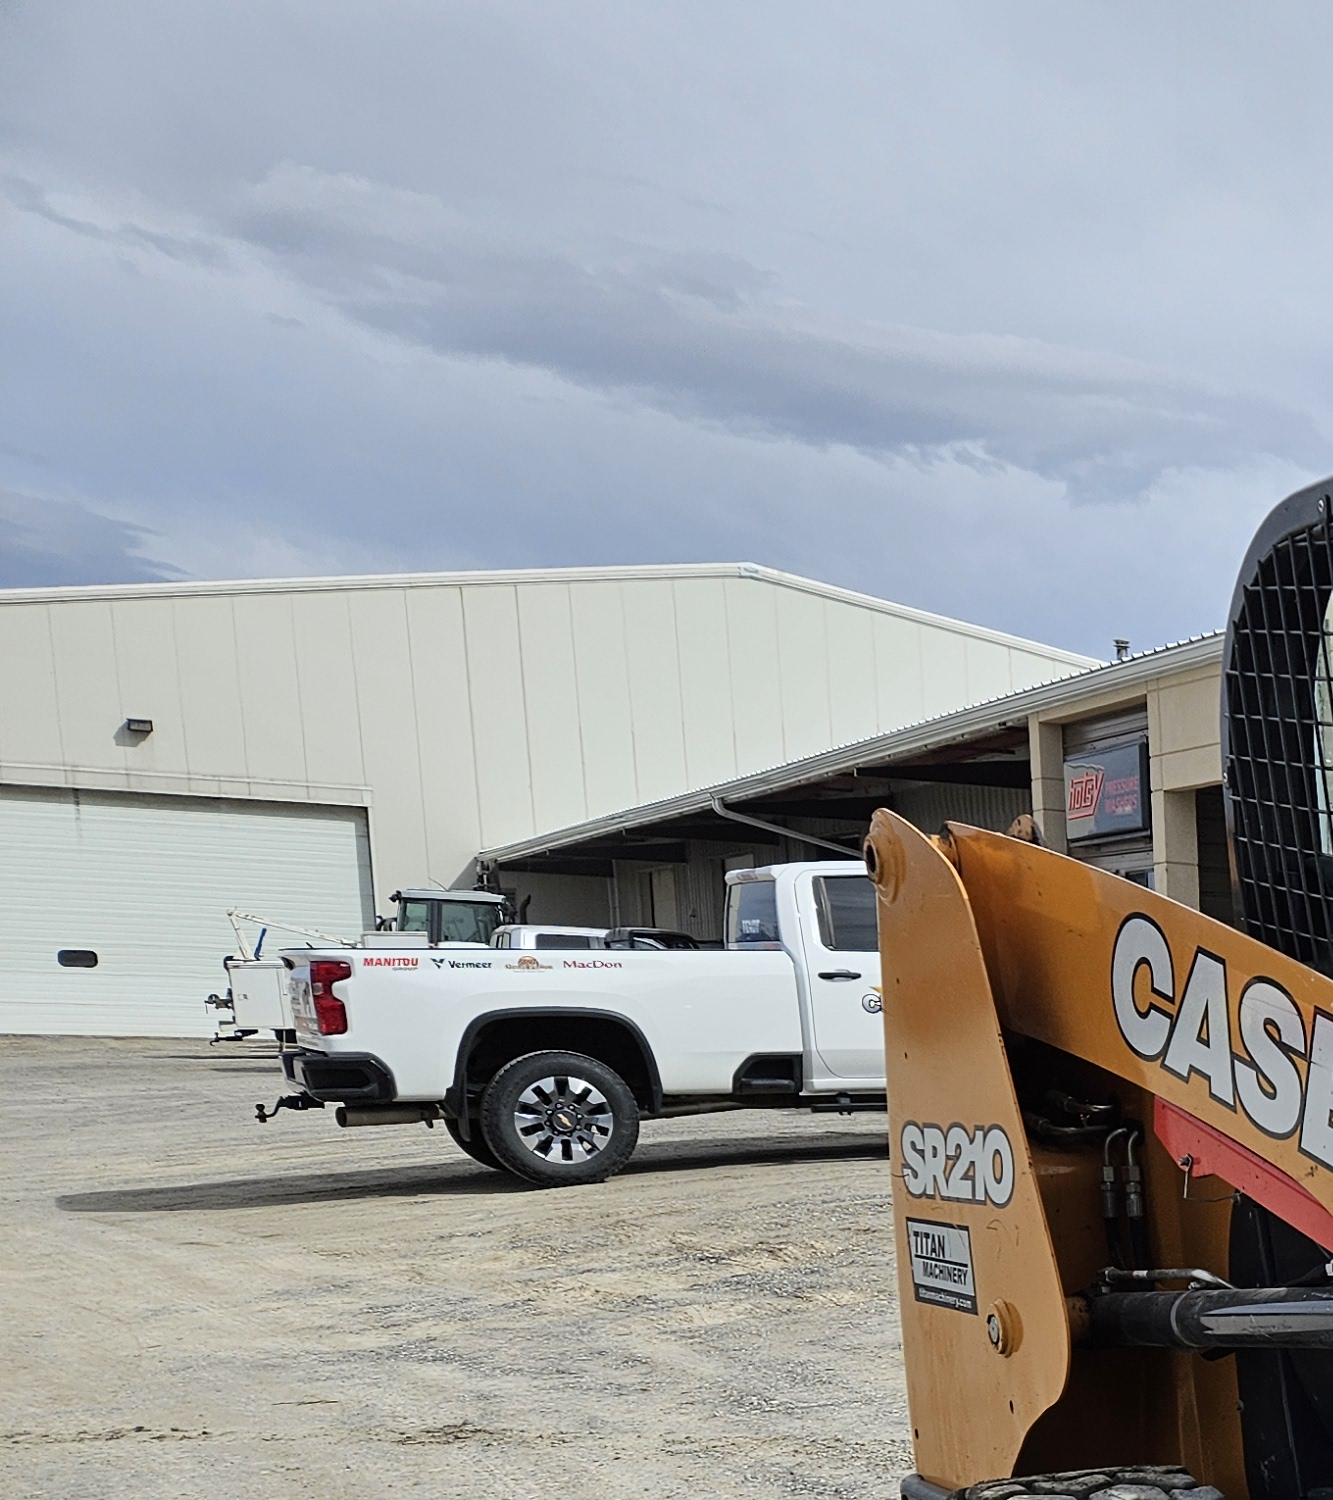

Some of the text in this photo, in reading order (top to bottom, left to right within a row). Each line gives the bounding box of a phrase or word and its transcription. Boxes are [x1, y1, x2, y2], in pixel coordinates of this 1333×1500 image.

[363, 957, 419, 967] MANITOU
[448, 960, 492, 969] Vermeer
[563, 960, 622, 969] MacDon
[902, 1120, 1014, 1208] SR210
[913, 1230, 946, 1259] TITAN
[923, 1261, 968, 1286] MACHINERY
